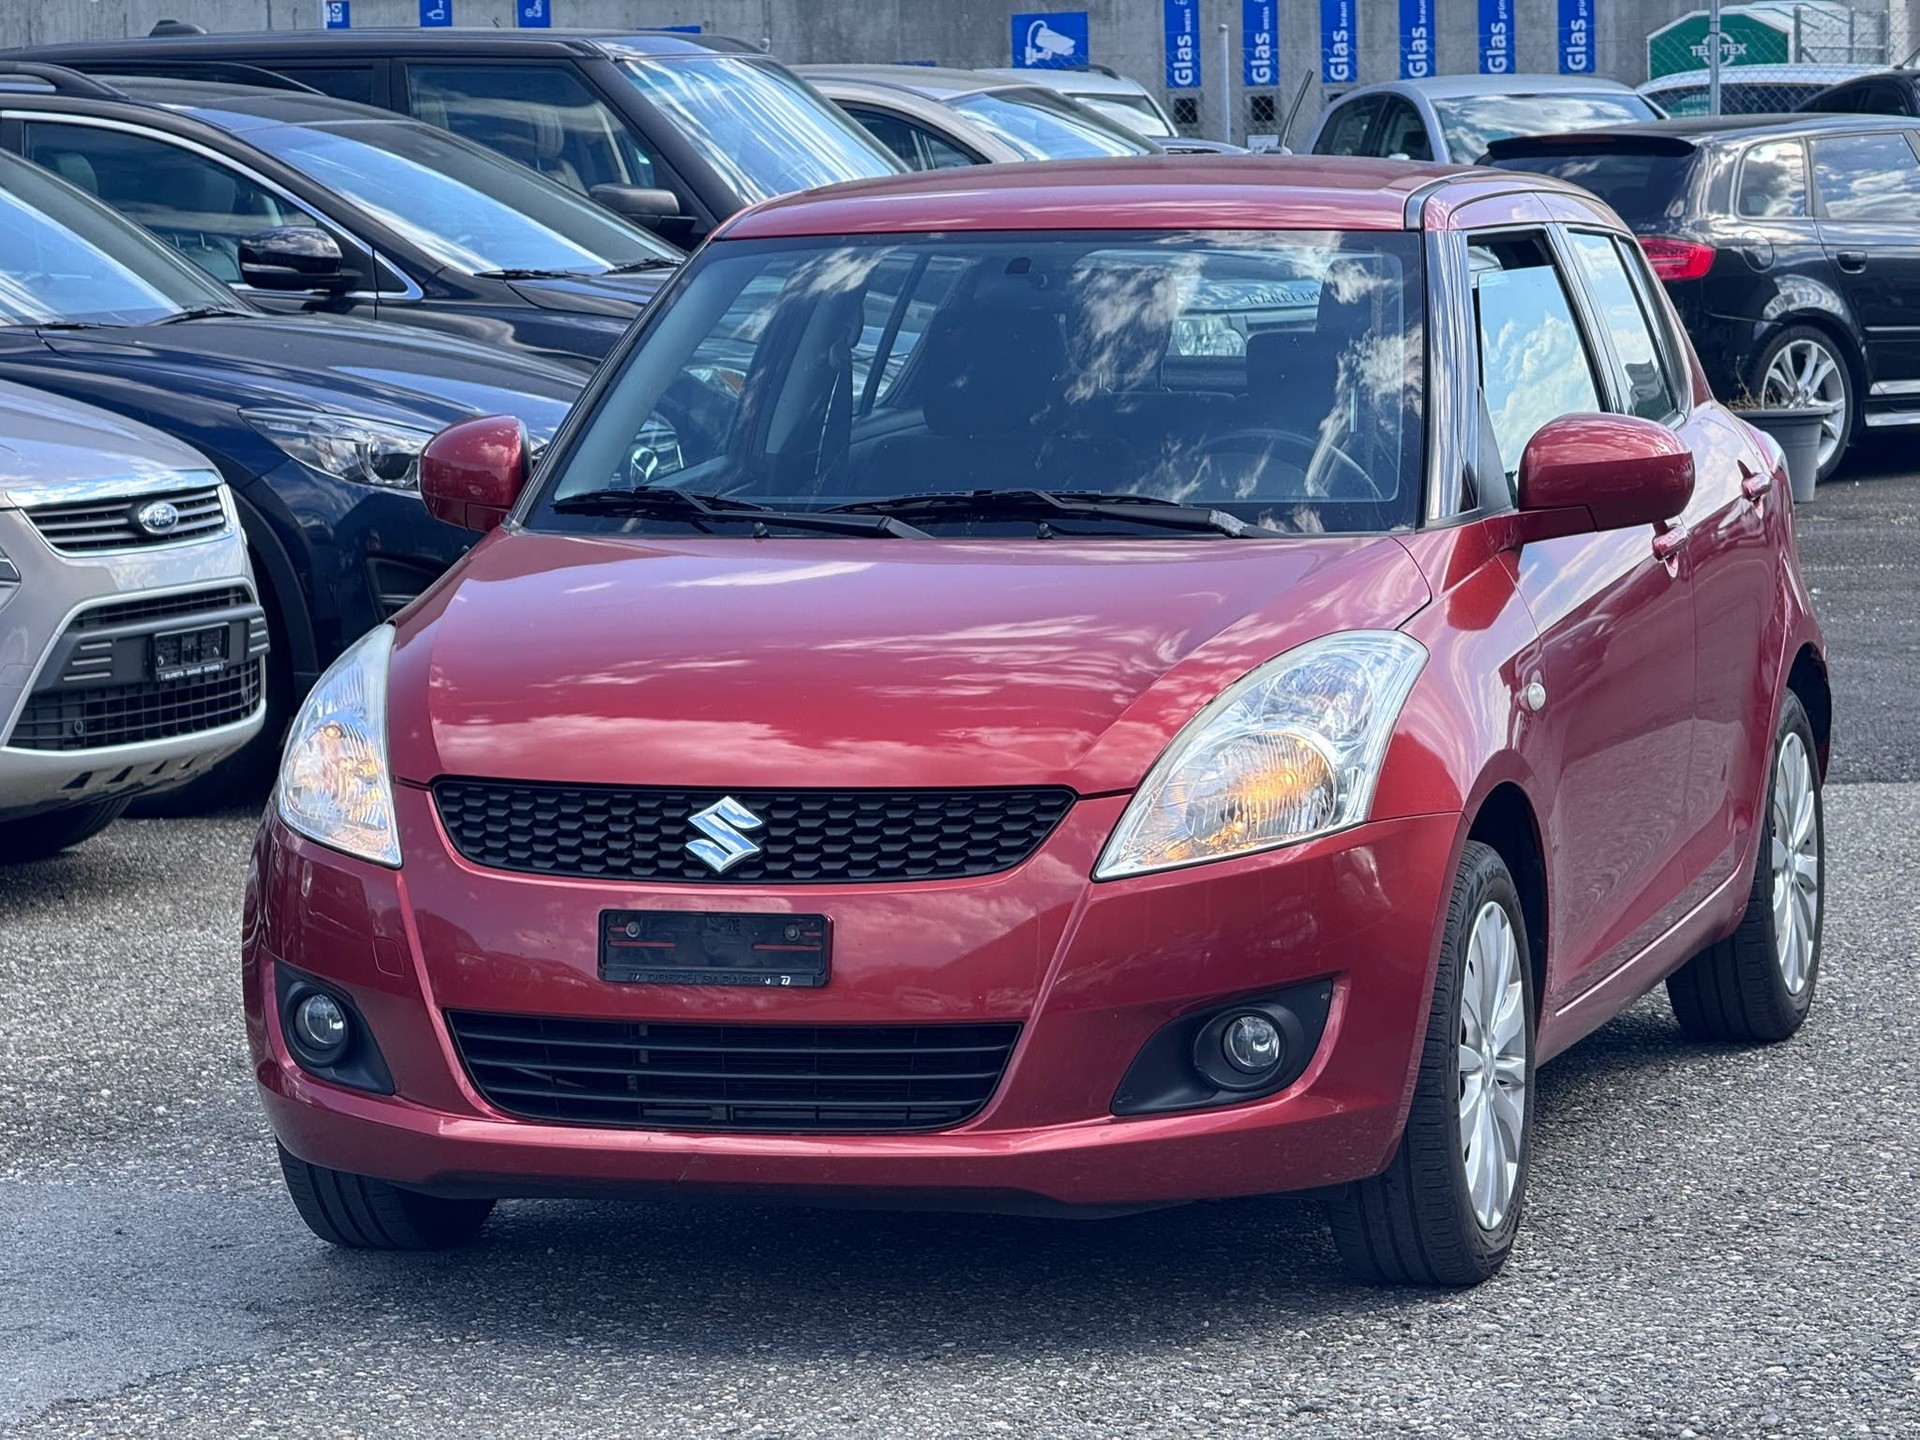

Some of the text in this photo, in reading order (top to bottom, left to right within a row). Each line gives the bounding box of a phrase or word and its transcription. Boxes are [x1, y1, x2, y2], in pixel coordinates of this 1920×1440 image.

[1173, 34, 1193, 85] Glas
[1250, 6, 1271, 84] Glas weiss
[1328, 1, 1349, 81] Glas braun
[1407, 26, 1428, 77] Glas
[1486, 22, 1507, 74] Glas
[1566, 0, 1588, 71] Glas grü
[153, 508, 174, 526] Ford
